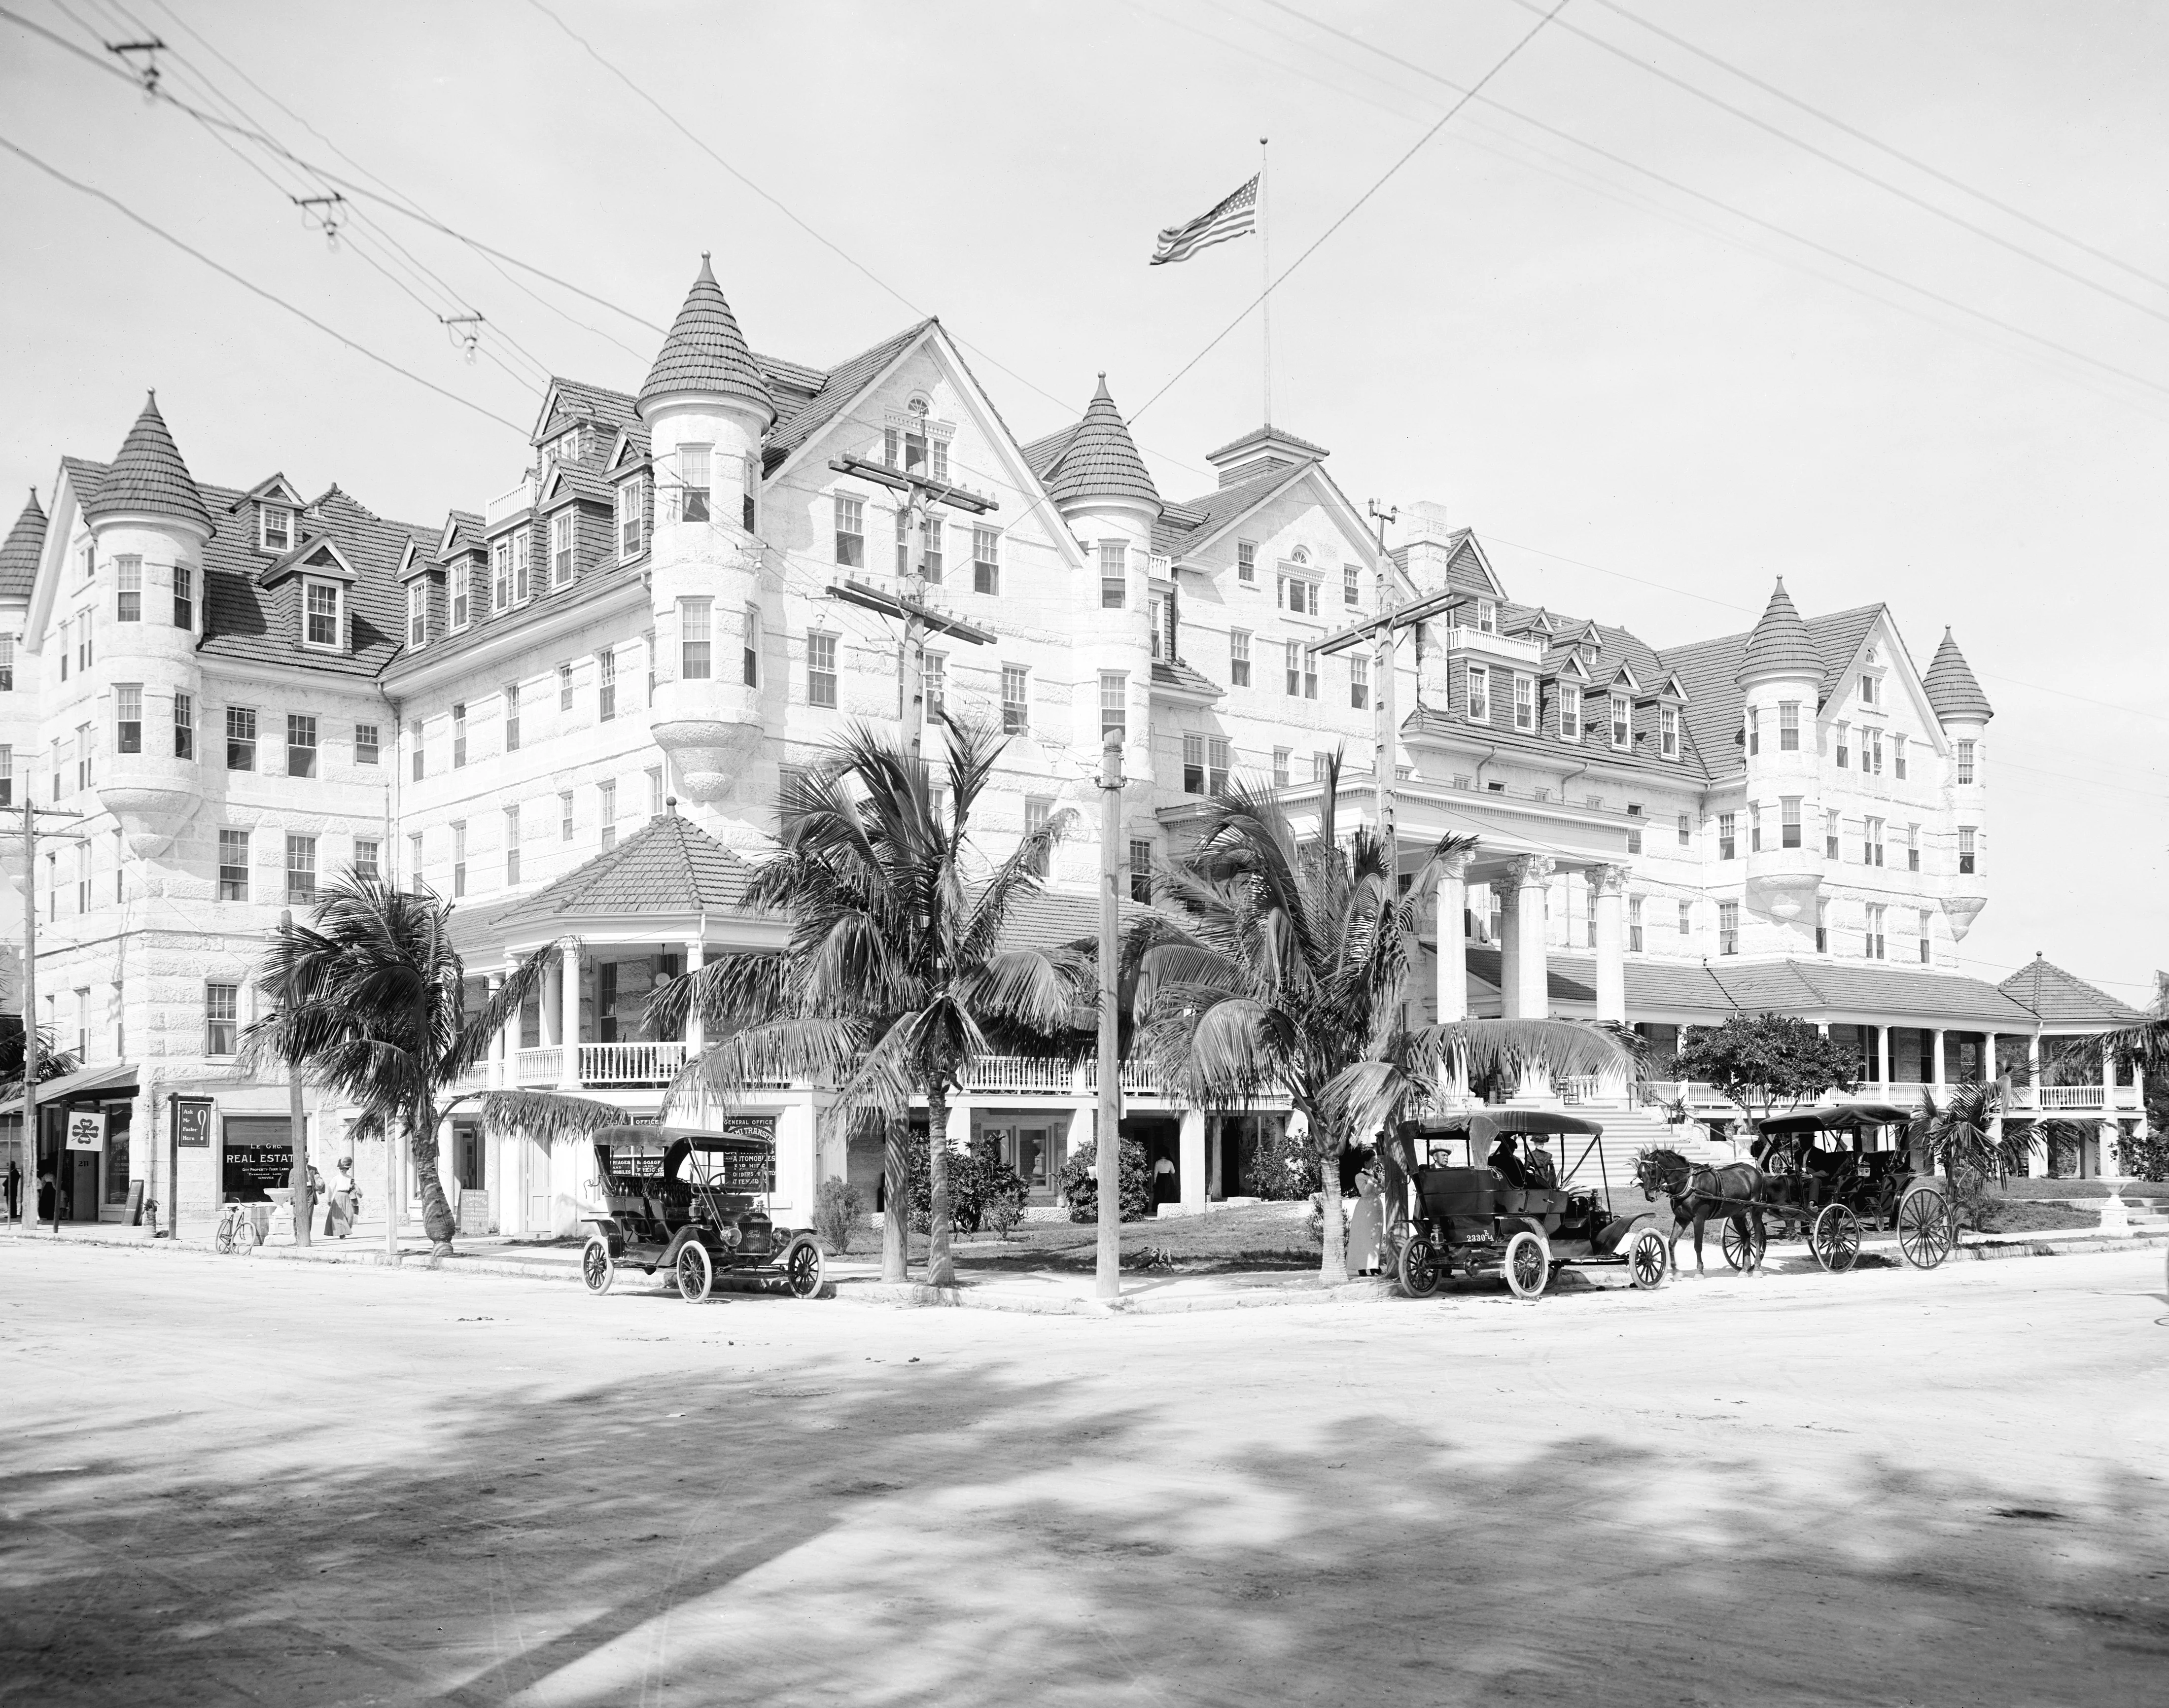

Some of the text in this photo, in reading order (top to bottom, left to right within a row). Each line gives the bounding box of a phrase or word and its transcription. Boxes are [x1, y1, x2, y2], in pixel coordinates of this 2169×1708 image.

[743, 1127, 776, 1145] TRANSFER
[227, 1154, 293, 1163] REAL ESTAT
[462, 1196, 488, 1205] TRANSFER
[1484, 1230, 1494, 1241] FLA
